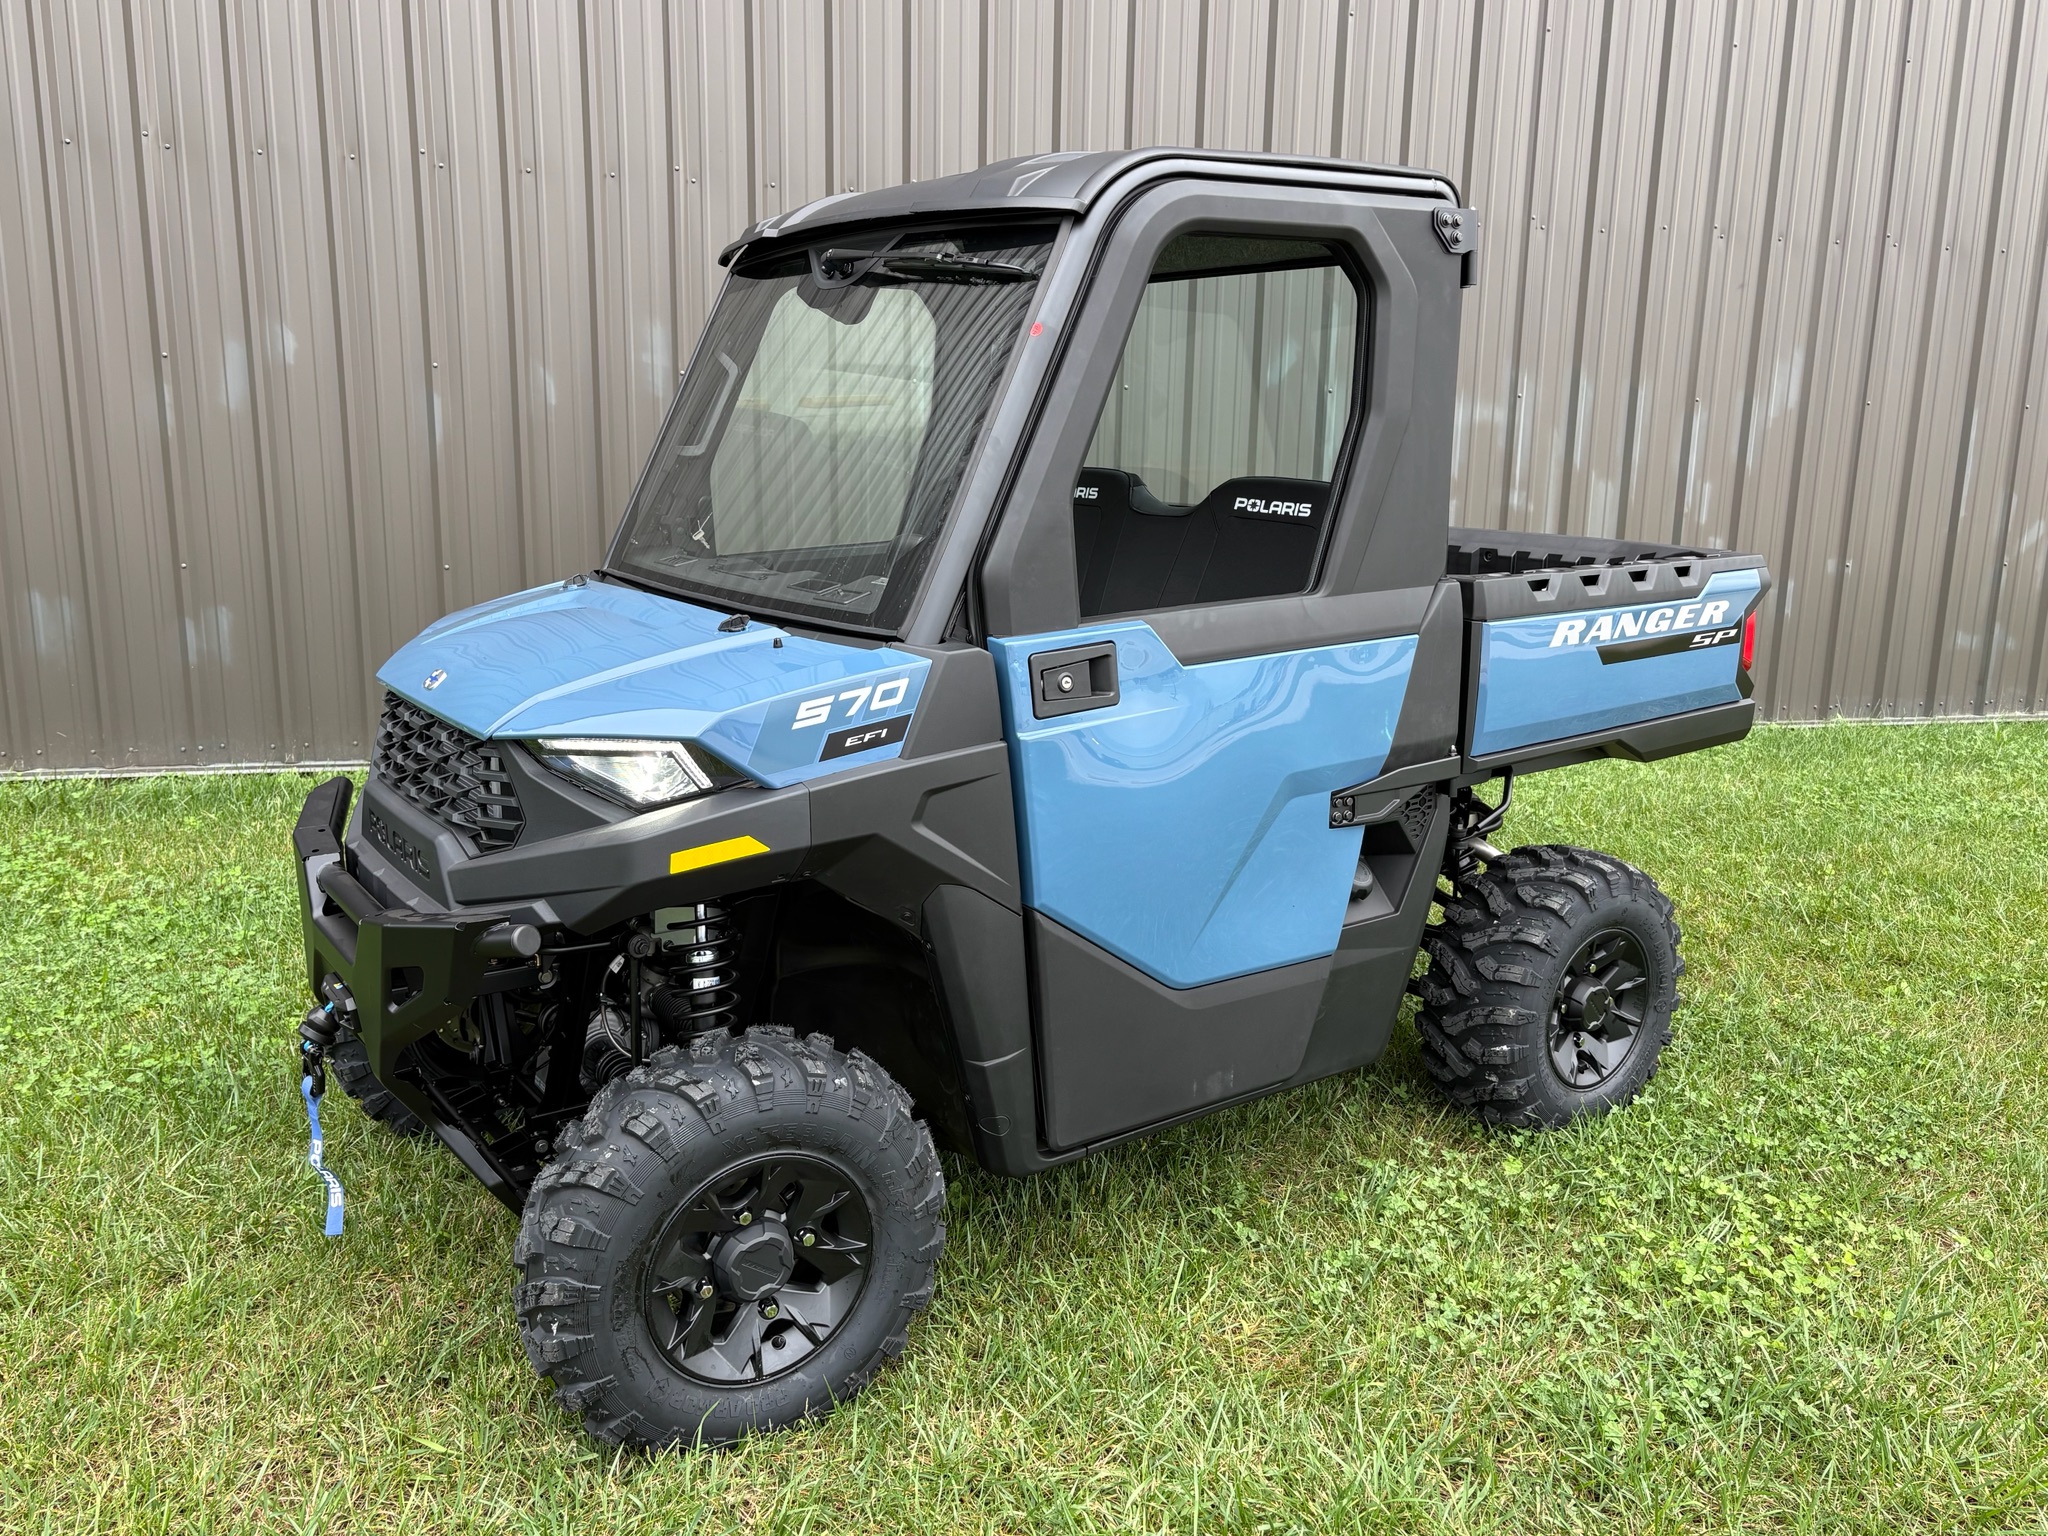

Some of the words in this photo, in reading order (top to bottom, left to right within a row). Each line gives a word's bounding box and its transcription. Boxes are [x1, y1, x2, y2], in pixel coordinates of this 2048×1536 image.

[1074, 487, 1099, 500] RIS
[1233, 497, 1312, 518] POLARIS
[1549, 600, 1730, 648] RANGER
[1689, 628, 1739, 648] SP
[791, 677, 910, 731] 570
[844, 728, 888, 748] EFI
[368, 808, 431, 882] POLARIS
[310, 1138, 342, 1208] POLARIS
